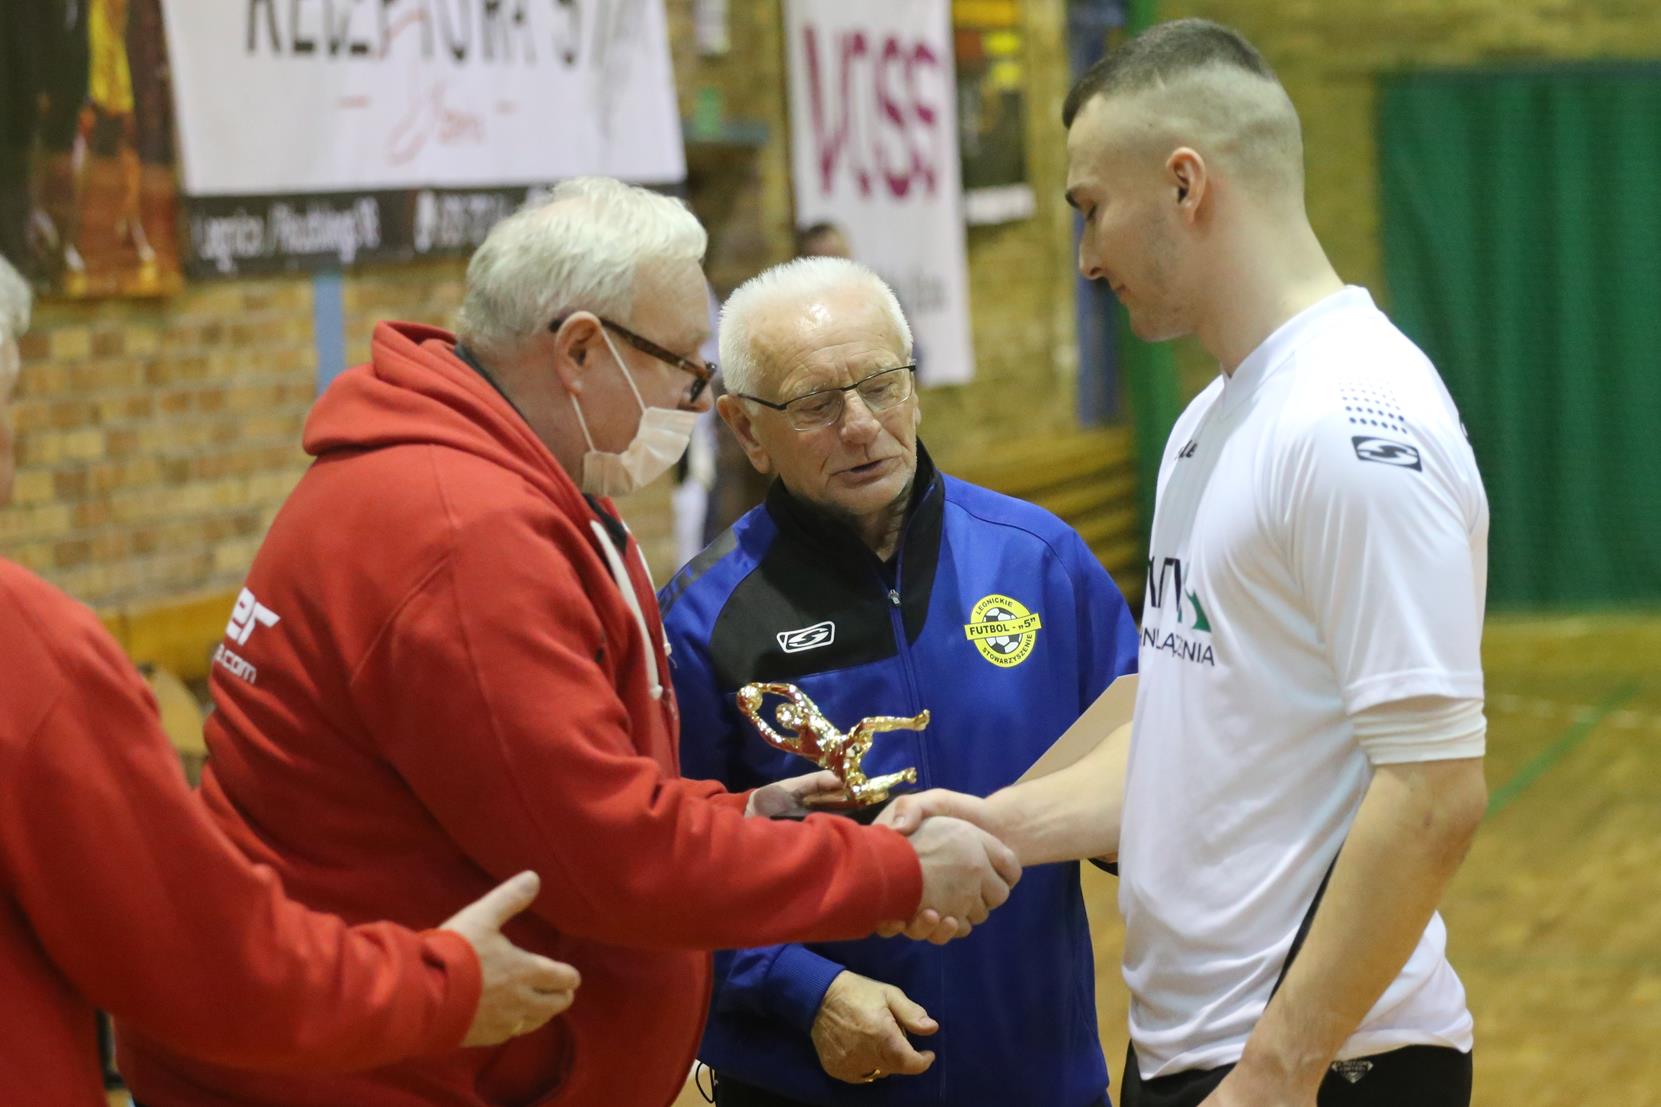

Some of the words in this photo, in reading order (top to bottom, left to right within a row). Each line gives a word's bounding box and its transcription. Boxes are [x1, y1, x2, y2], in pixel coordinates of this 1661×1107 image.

[975, 597, 1014, 615] LEGNICKIE
[969, 623, 1010, 636] FUTBOL
[981, 633, 1033, 665] STOWARZYSZENIE
